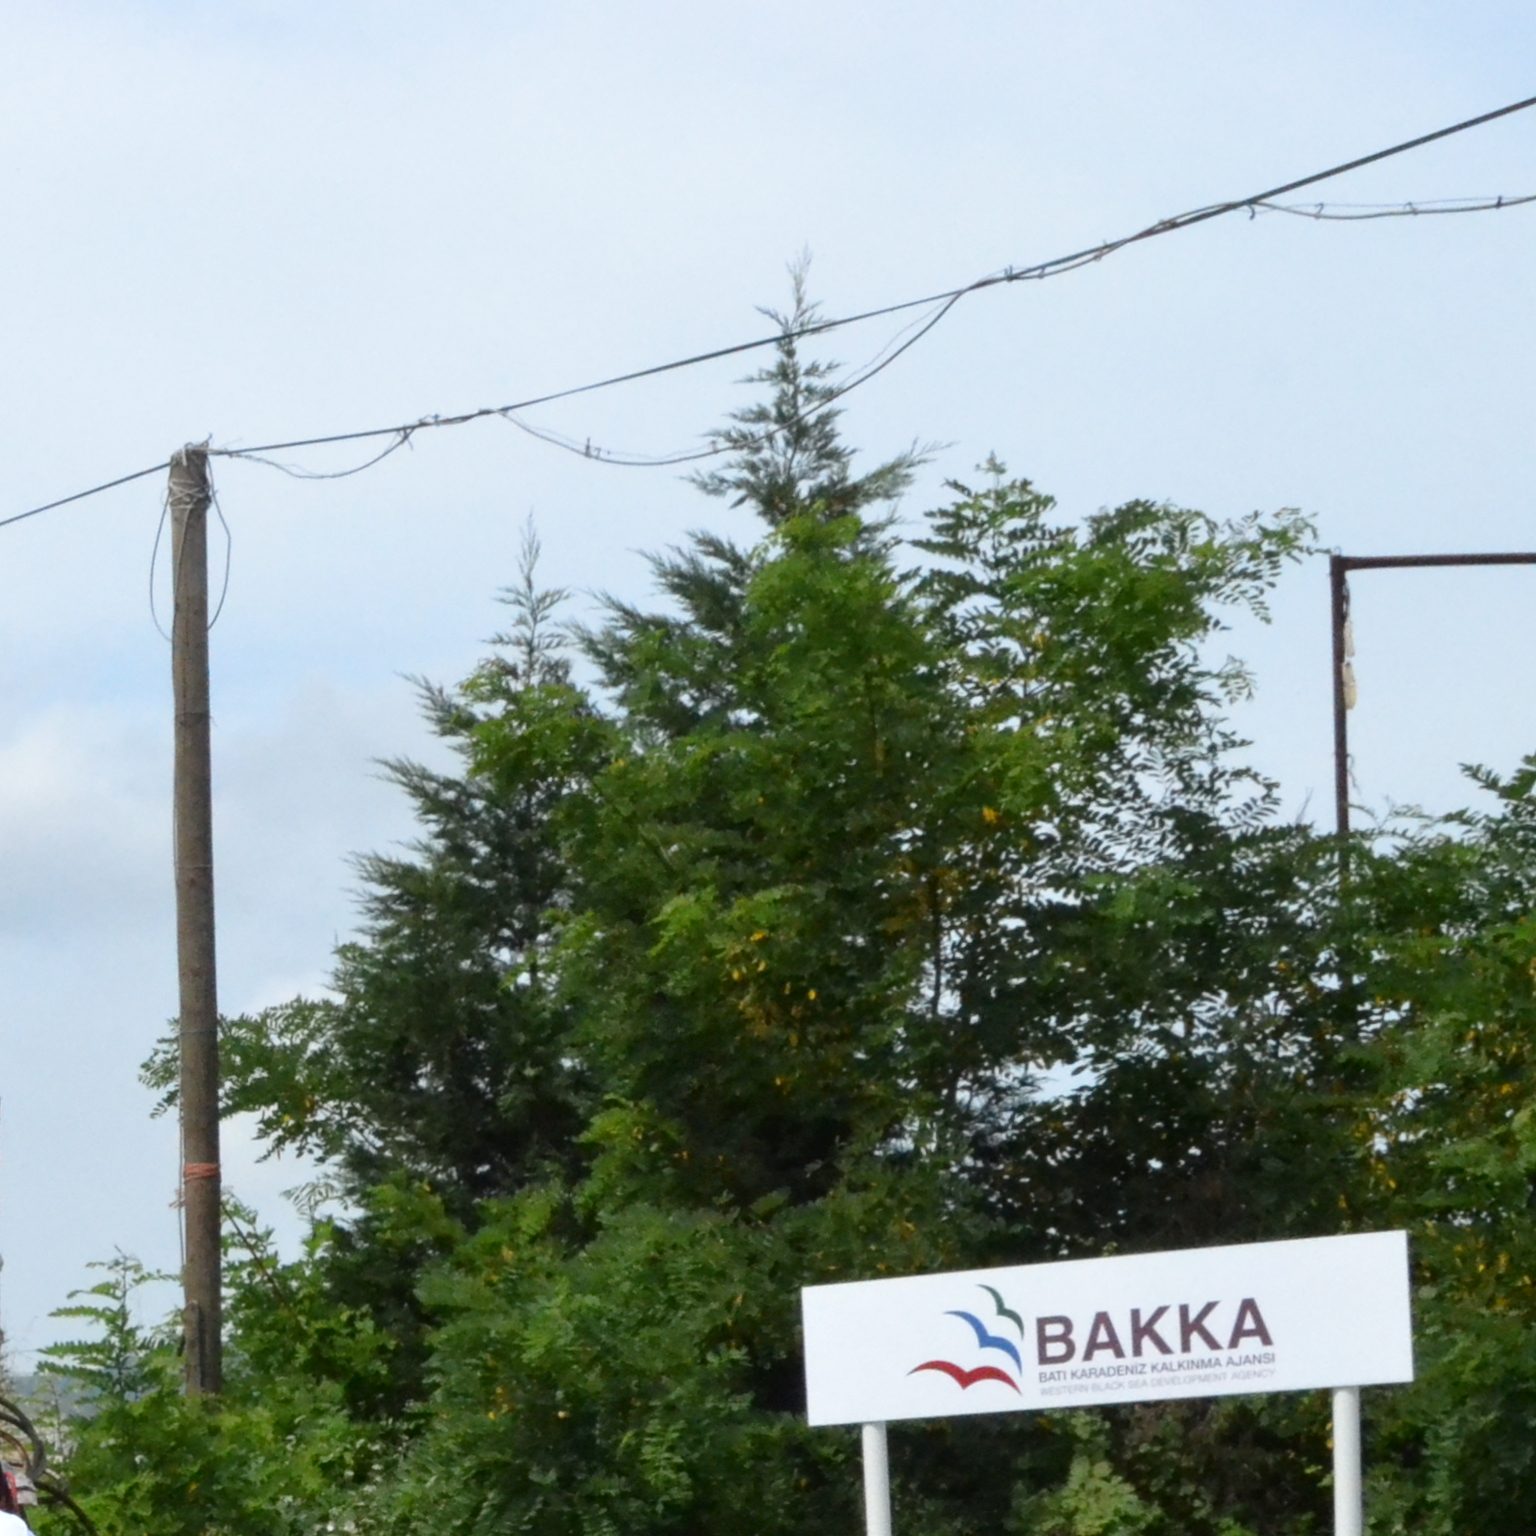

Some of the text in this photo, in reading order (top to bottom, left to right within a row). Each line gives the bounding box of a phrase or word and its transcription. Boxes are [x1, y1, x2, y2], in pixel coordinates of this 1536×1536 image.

[1036, 1297, 1274, 1365] BAKKA
[1038, 1352, 1275, 1383] BATI KARADENİZ KALKINMA AJANSI
[1040, 1368, 1276, 1397] WESTERN BLACK SEA DEVELOPMENT AGENCY
